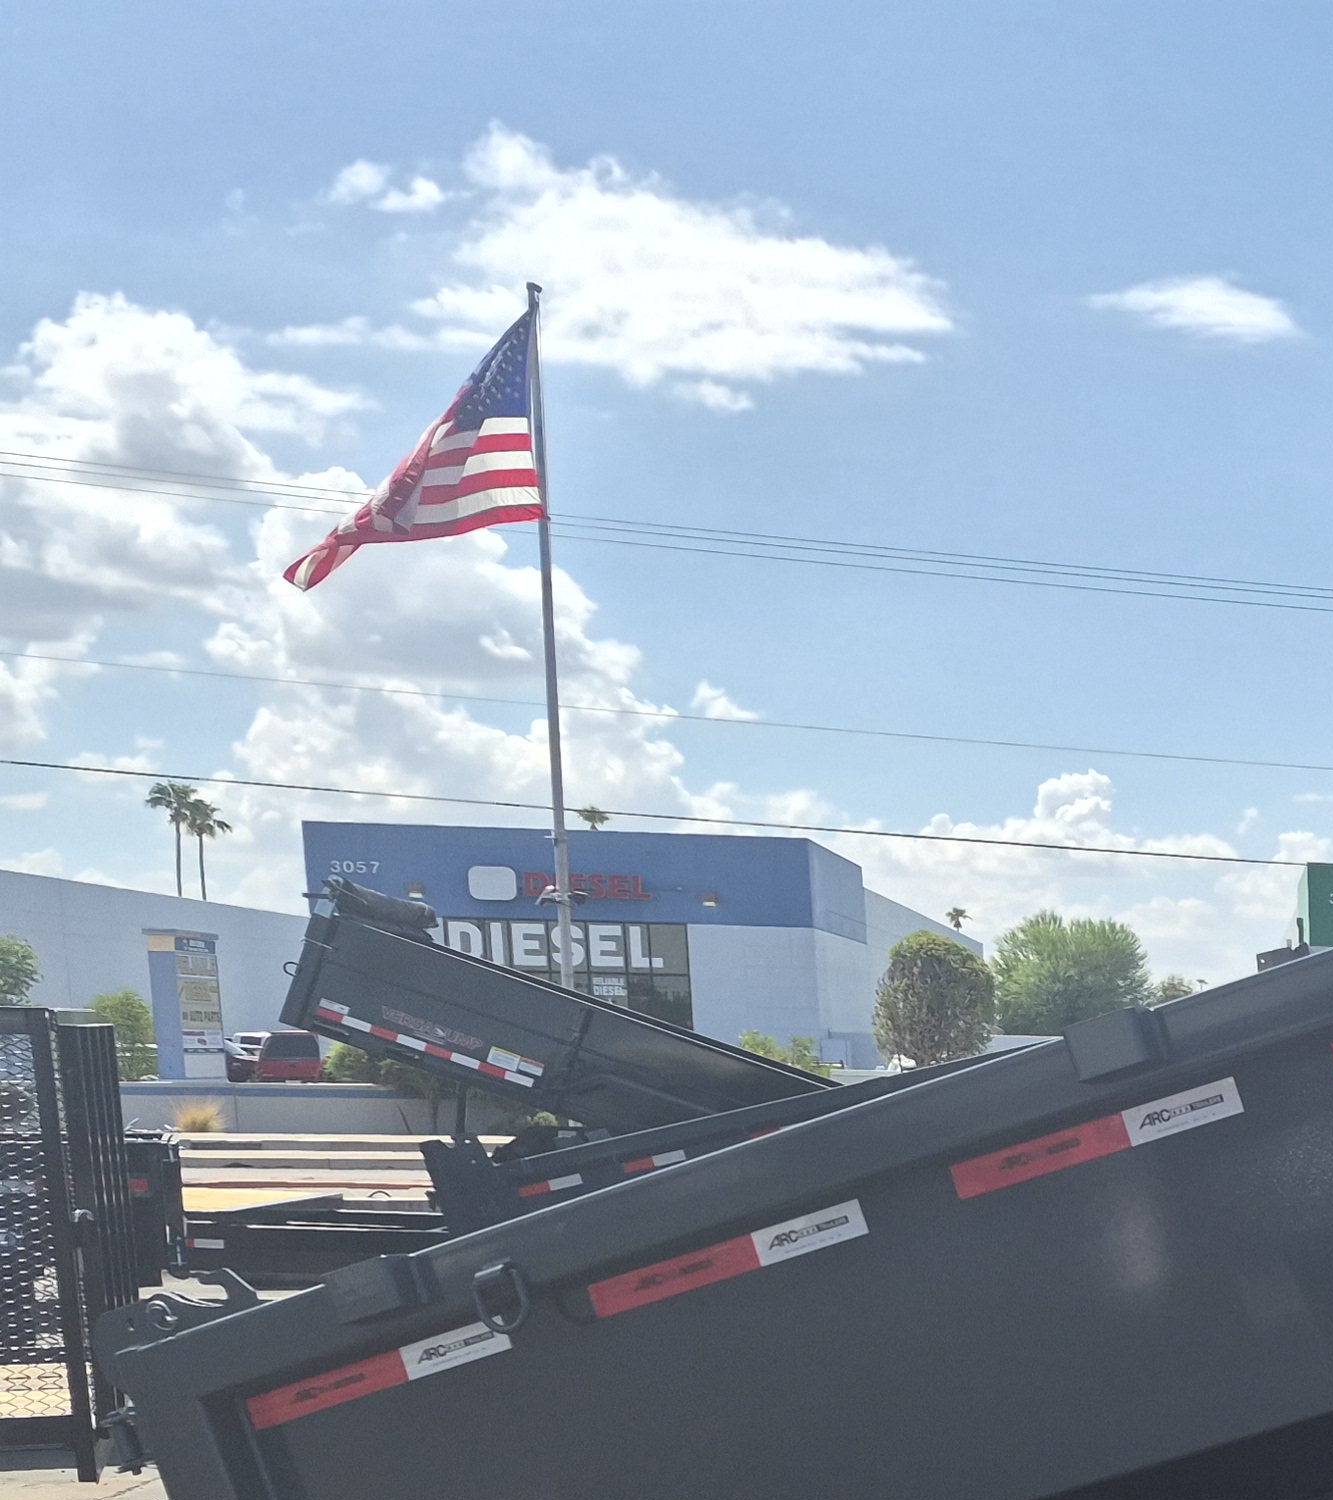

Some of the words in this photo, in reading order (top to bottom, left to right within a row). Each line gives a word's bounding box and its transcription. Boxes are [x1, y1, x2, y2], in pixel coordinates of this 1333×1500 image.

[330, 860, 380, 874] 3057
[447, 921, 664, 968] DIESEL
[1139, 1109, 1171, 1129] ARC
[768, 1230, 799, 1250] ARC
[417, 1344, 447, 1365] ARC
